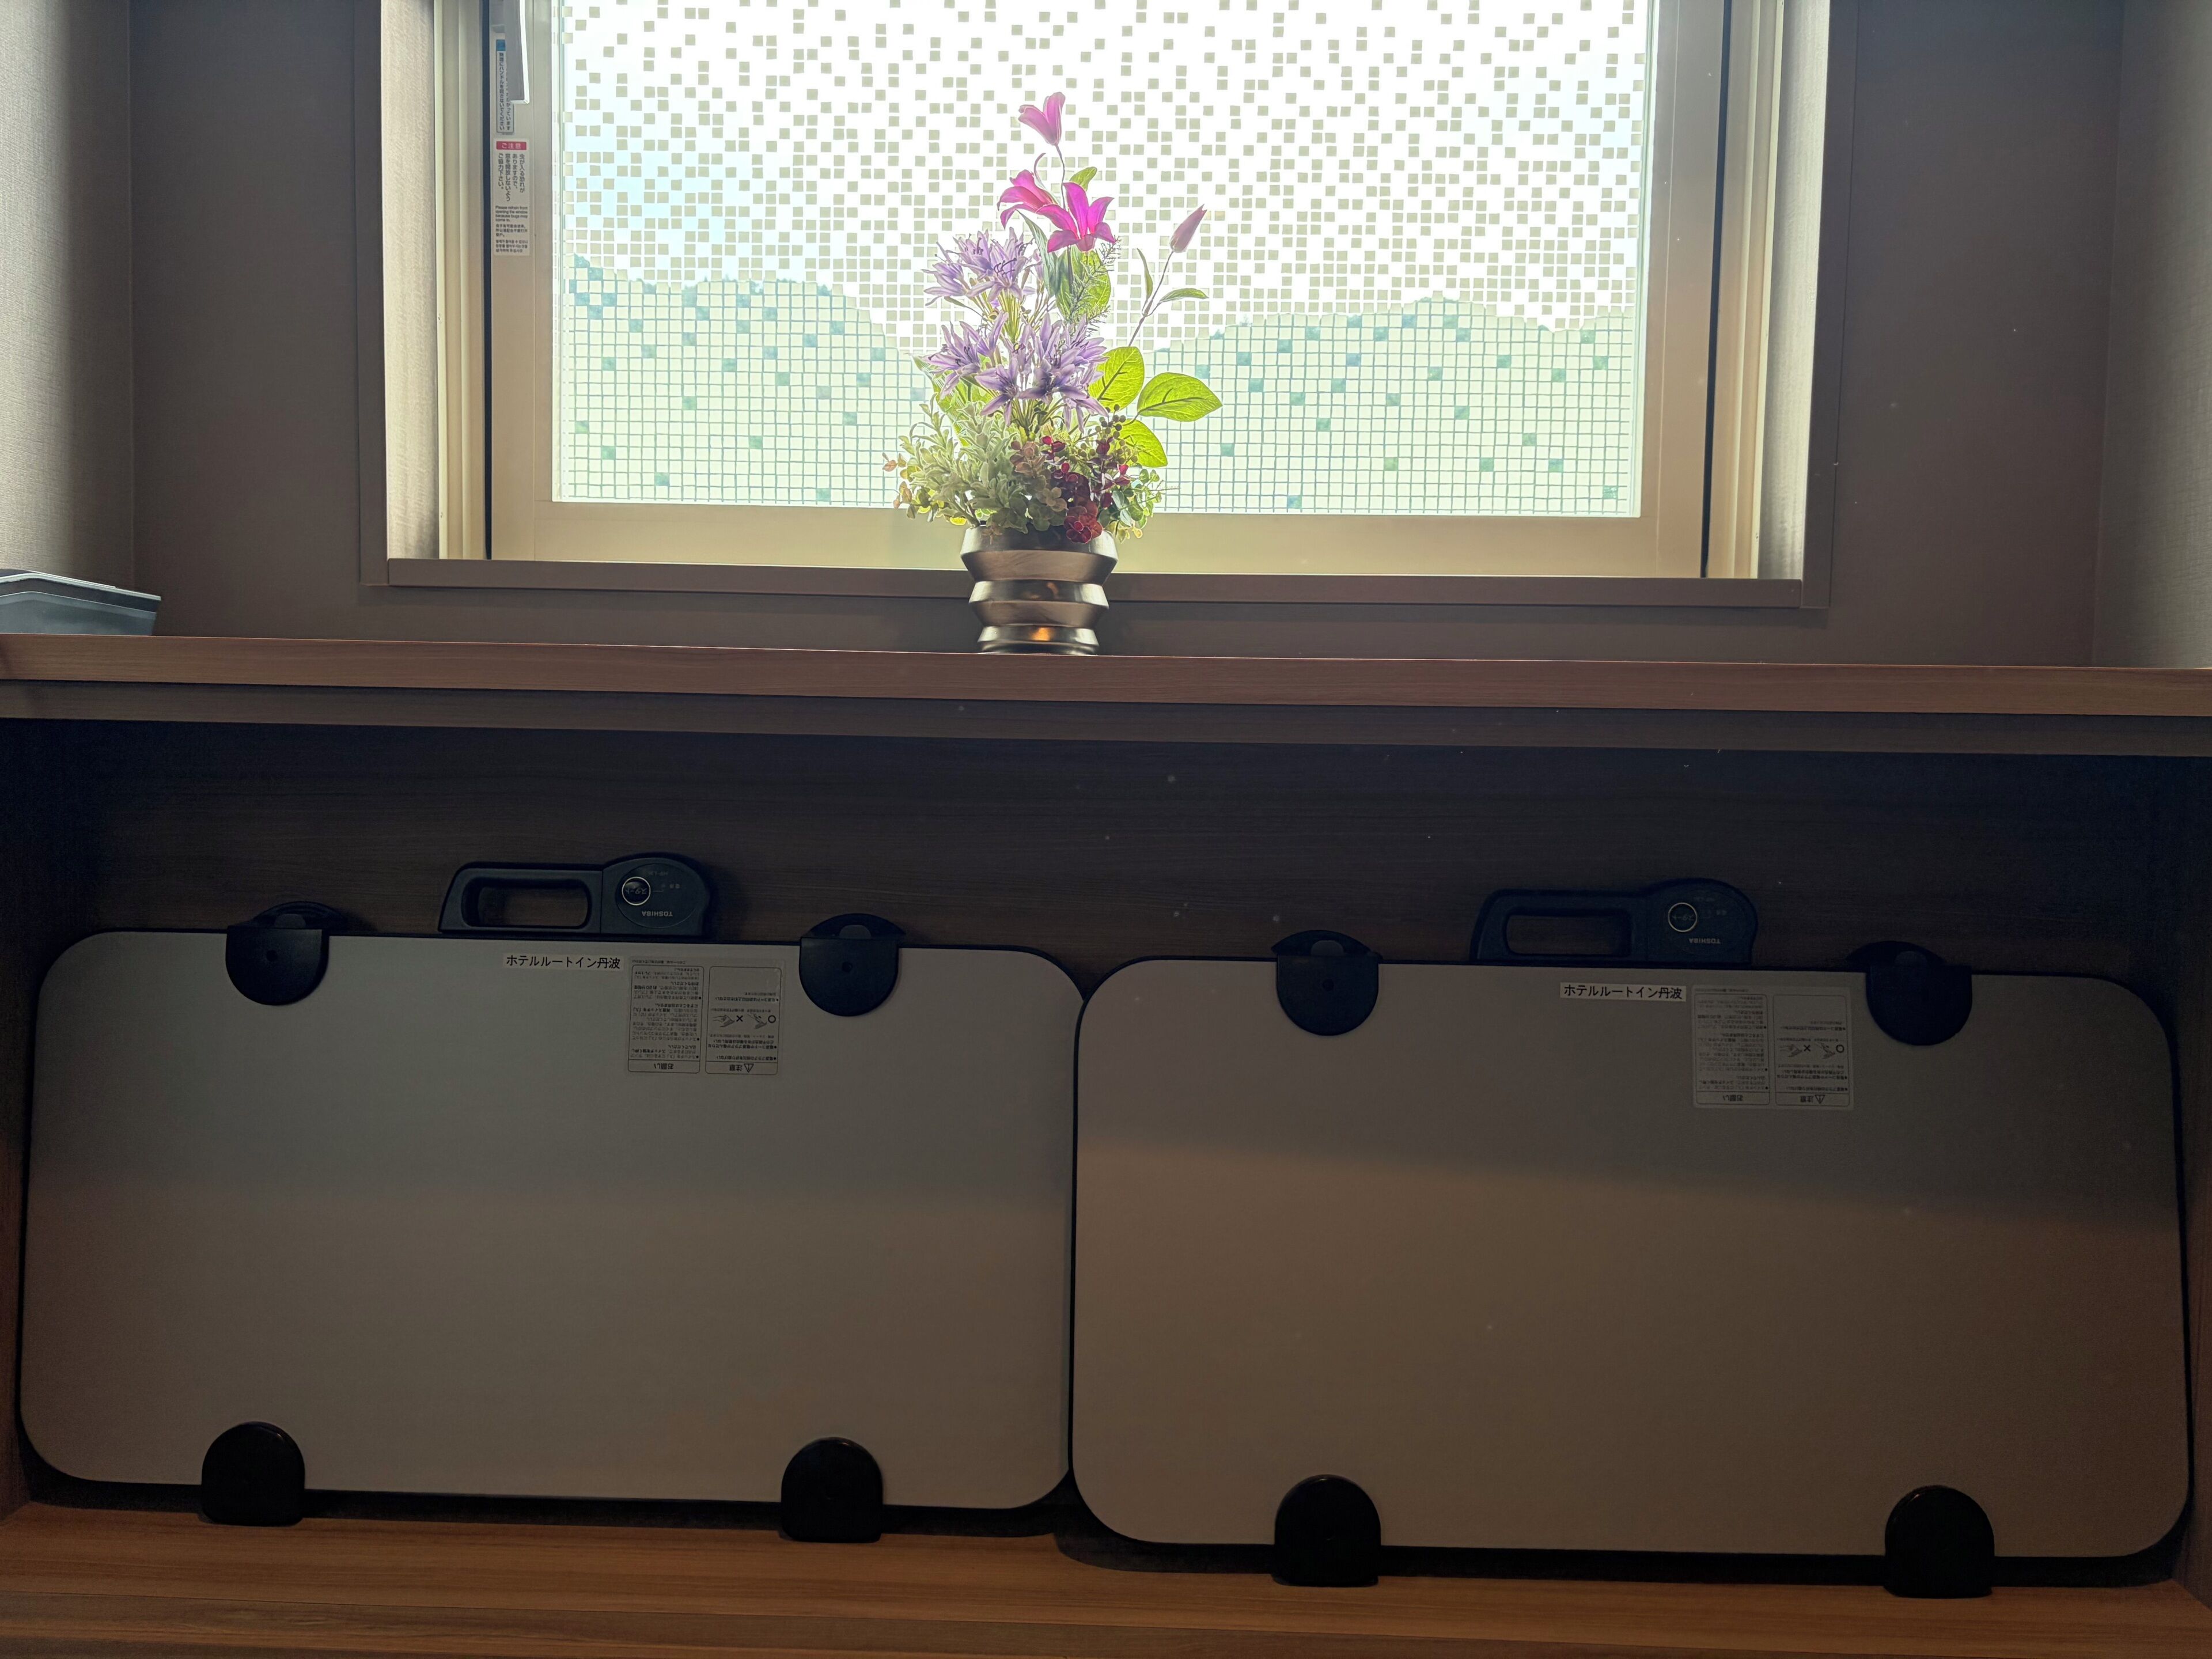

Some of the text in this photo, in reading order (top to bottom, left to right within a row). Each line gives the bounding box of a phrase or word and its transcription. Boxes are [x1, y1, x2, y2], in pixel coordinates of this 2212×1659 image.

[506, 955, 620, 969] ホテルルートイン丹波
[1564, 984, 1683, 999] ホテルルートイン丹波
